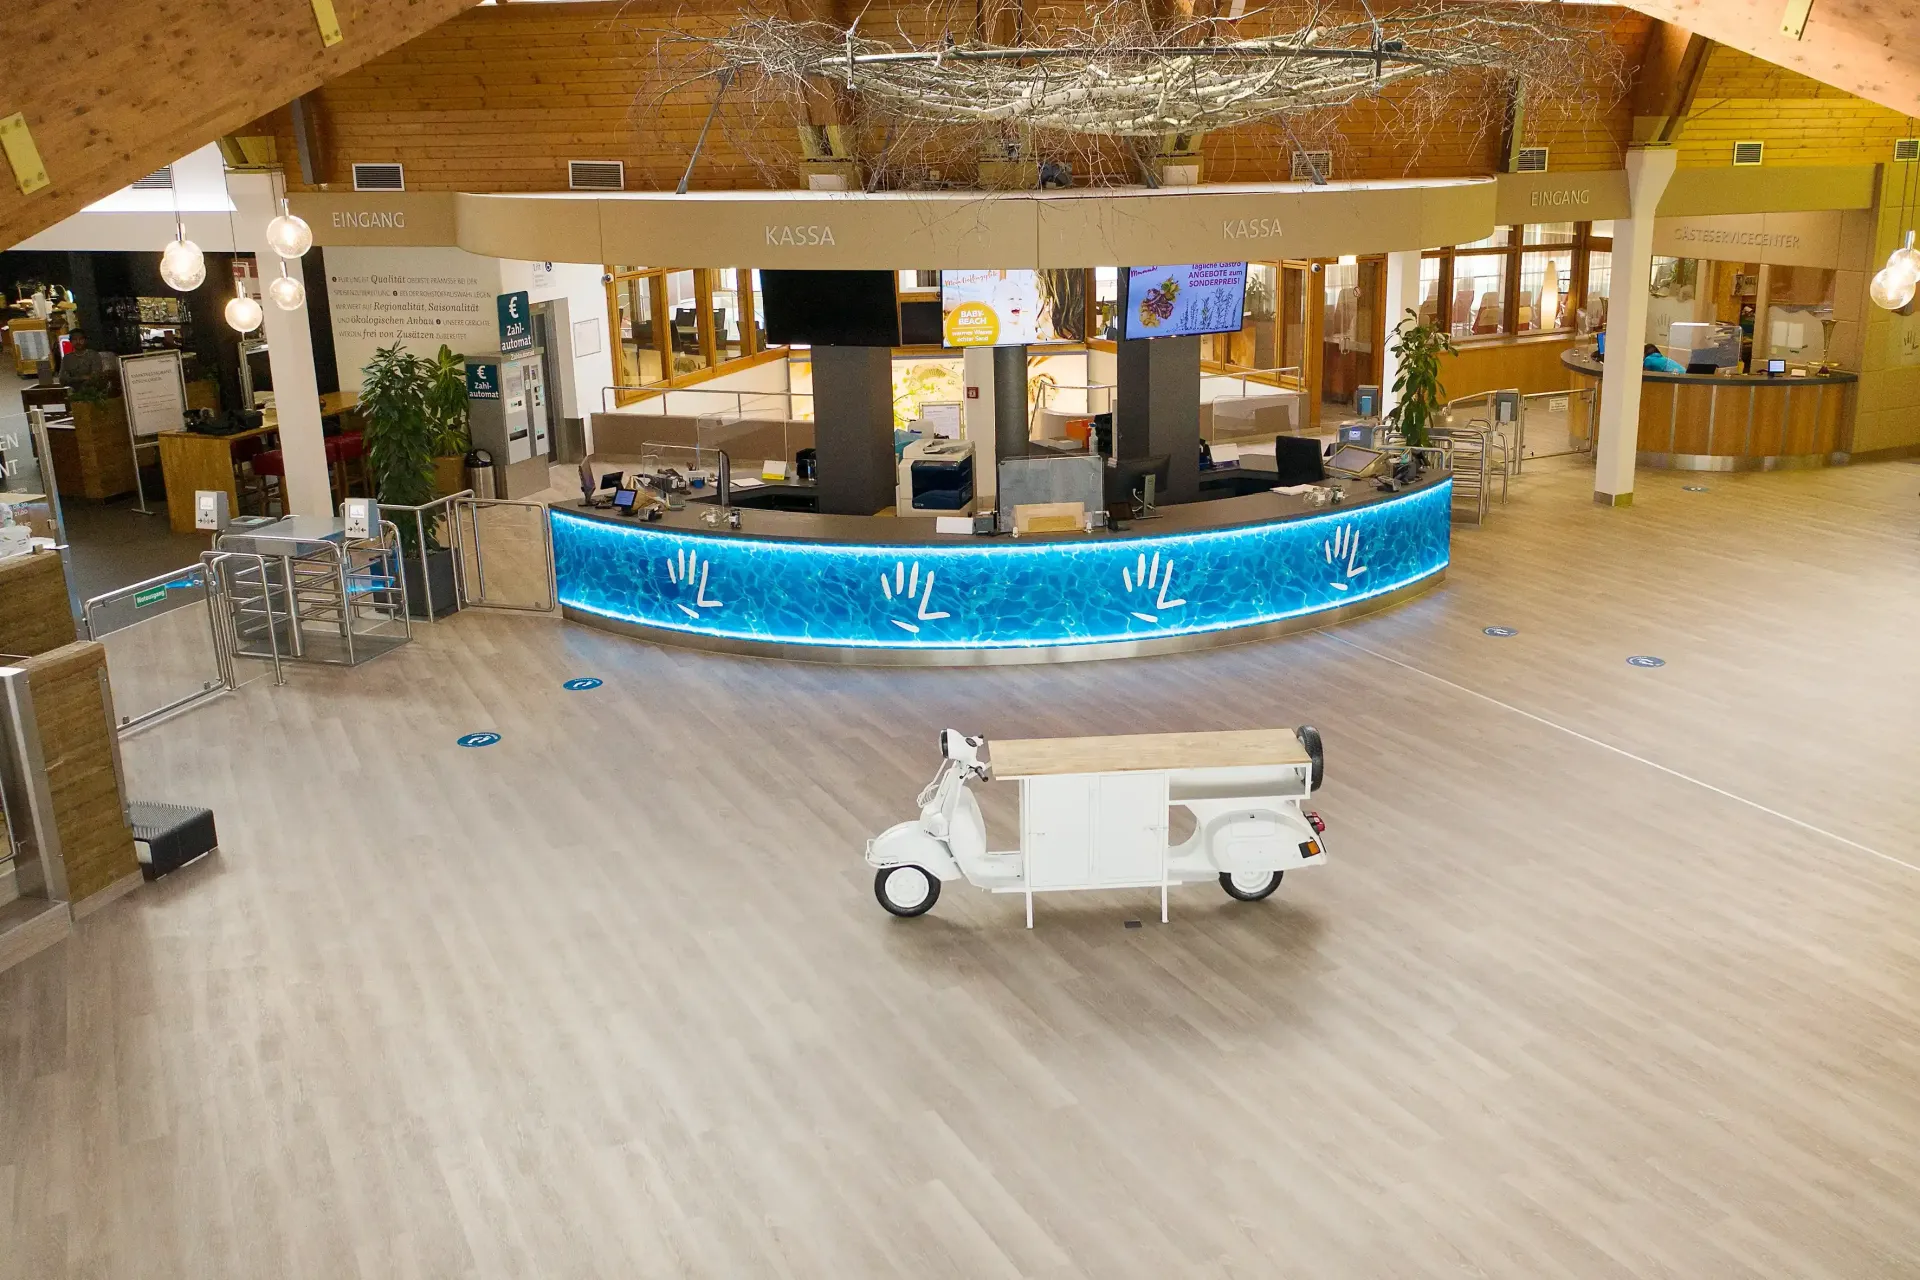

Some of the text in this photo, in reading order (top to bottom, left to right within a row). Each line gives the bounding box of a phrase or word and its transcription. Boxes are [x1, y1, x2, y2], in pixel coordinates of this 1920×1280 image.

[1530, 189, 1590, 207] EINGANG
[332, 211, 406, 228] EINGANG
[1222, 218, 1283, 239] KASSA
[764, 225, 836, 246] KASSA
[1674, 226, 1800, 249] GÄSTESERVICECENTER
[370, 274, 406, 285] Qualität
[1188, 270, 1227, 278] ANGEBOTE
[1189, 277, 1240, 287] SONDERPREIS!
[428, 302, 480, 312] Saisonalität
[350, 314, 405, 326] ökologischen
[406, 316, 434, 325] Anbau
[960, 310, 984, 318] BABY-
[958, 317, 987, 325] BEACH
[362, 328, 377, 340] frei
[396, 329, 434, 339] Zusätzen
[506, 323, 525, 336] Zahl-
[501, 335, 532, 351] automat
[474, 381, 492, 390] Zahl-
[469, 389, 499, 398] automat
